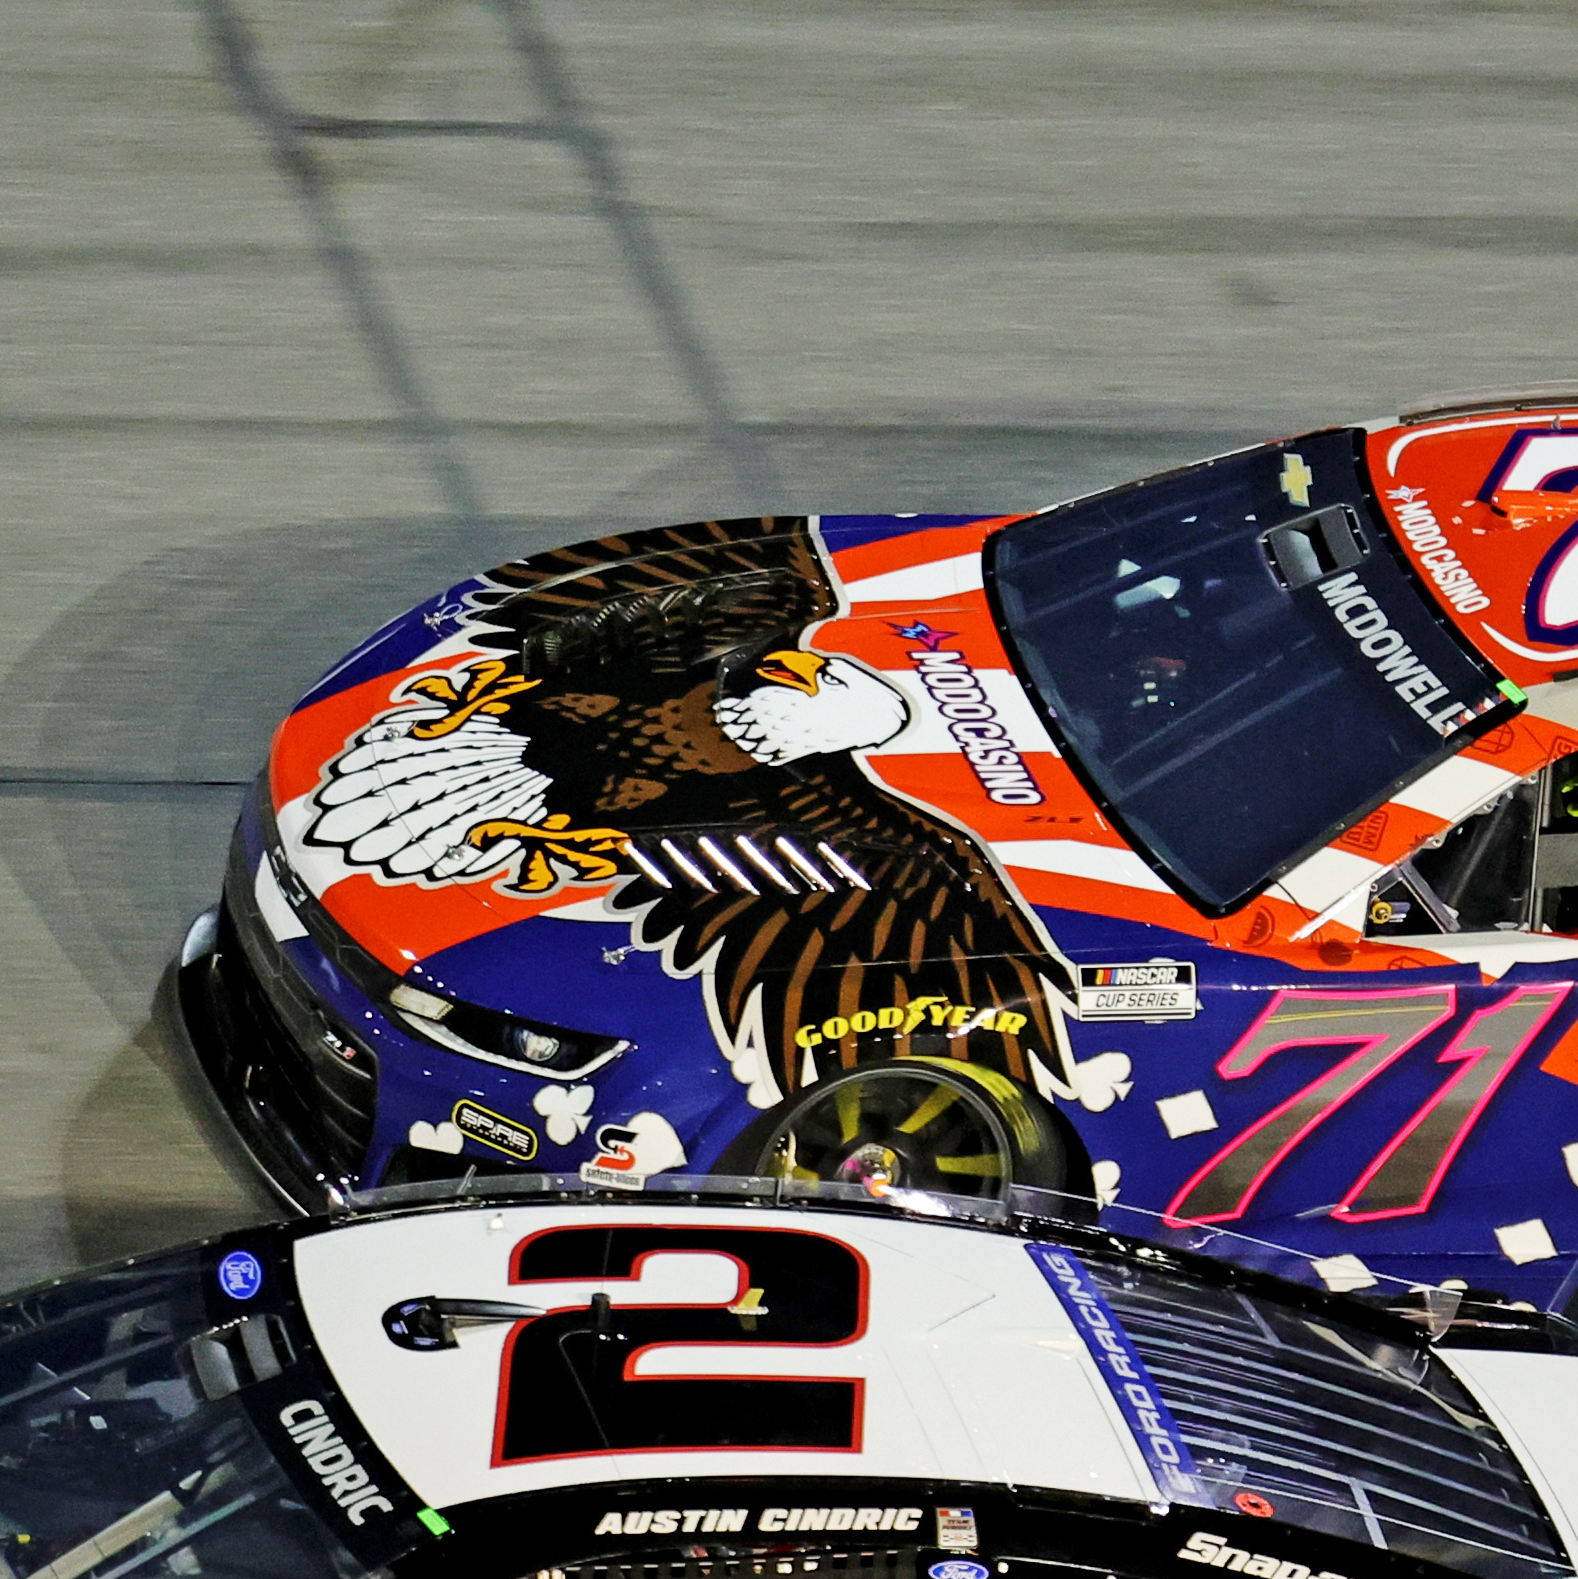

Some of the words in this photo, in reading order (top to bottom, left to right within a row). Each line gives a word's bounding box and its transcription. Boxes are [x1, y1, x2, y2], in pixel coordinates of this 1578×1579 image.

[1318, 572, 1467, 737] MCDOWELL
[795, 996, 1028, 1049] GOODYEAR
[1096, 992, 1128, 1008] CUP
[1130, 991, 1179, 1008] SERIES
[1114, 967, 1178, 985] NASCAR
[461, 1106, 530, 1149] SPIRE
[1164, 981, 1575, 1228] 71
[490, 1223, 870, 1469] 2
[1042, 1251, 1141, 1380] RACING
[279, 1399, 394, 1526] CINDRIC
[1124, 1383, 1197, 1494] FORD
[594, 1509, 749, 1536] AUSTIN
[757, 1507, 923, 1532] CINDRIC
